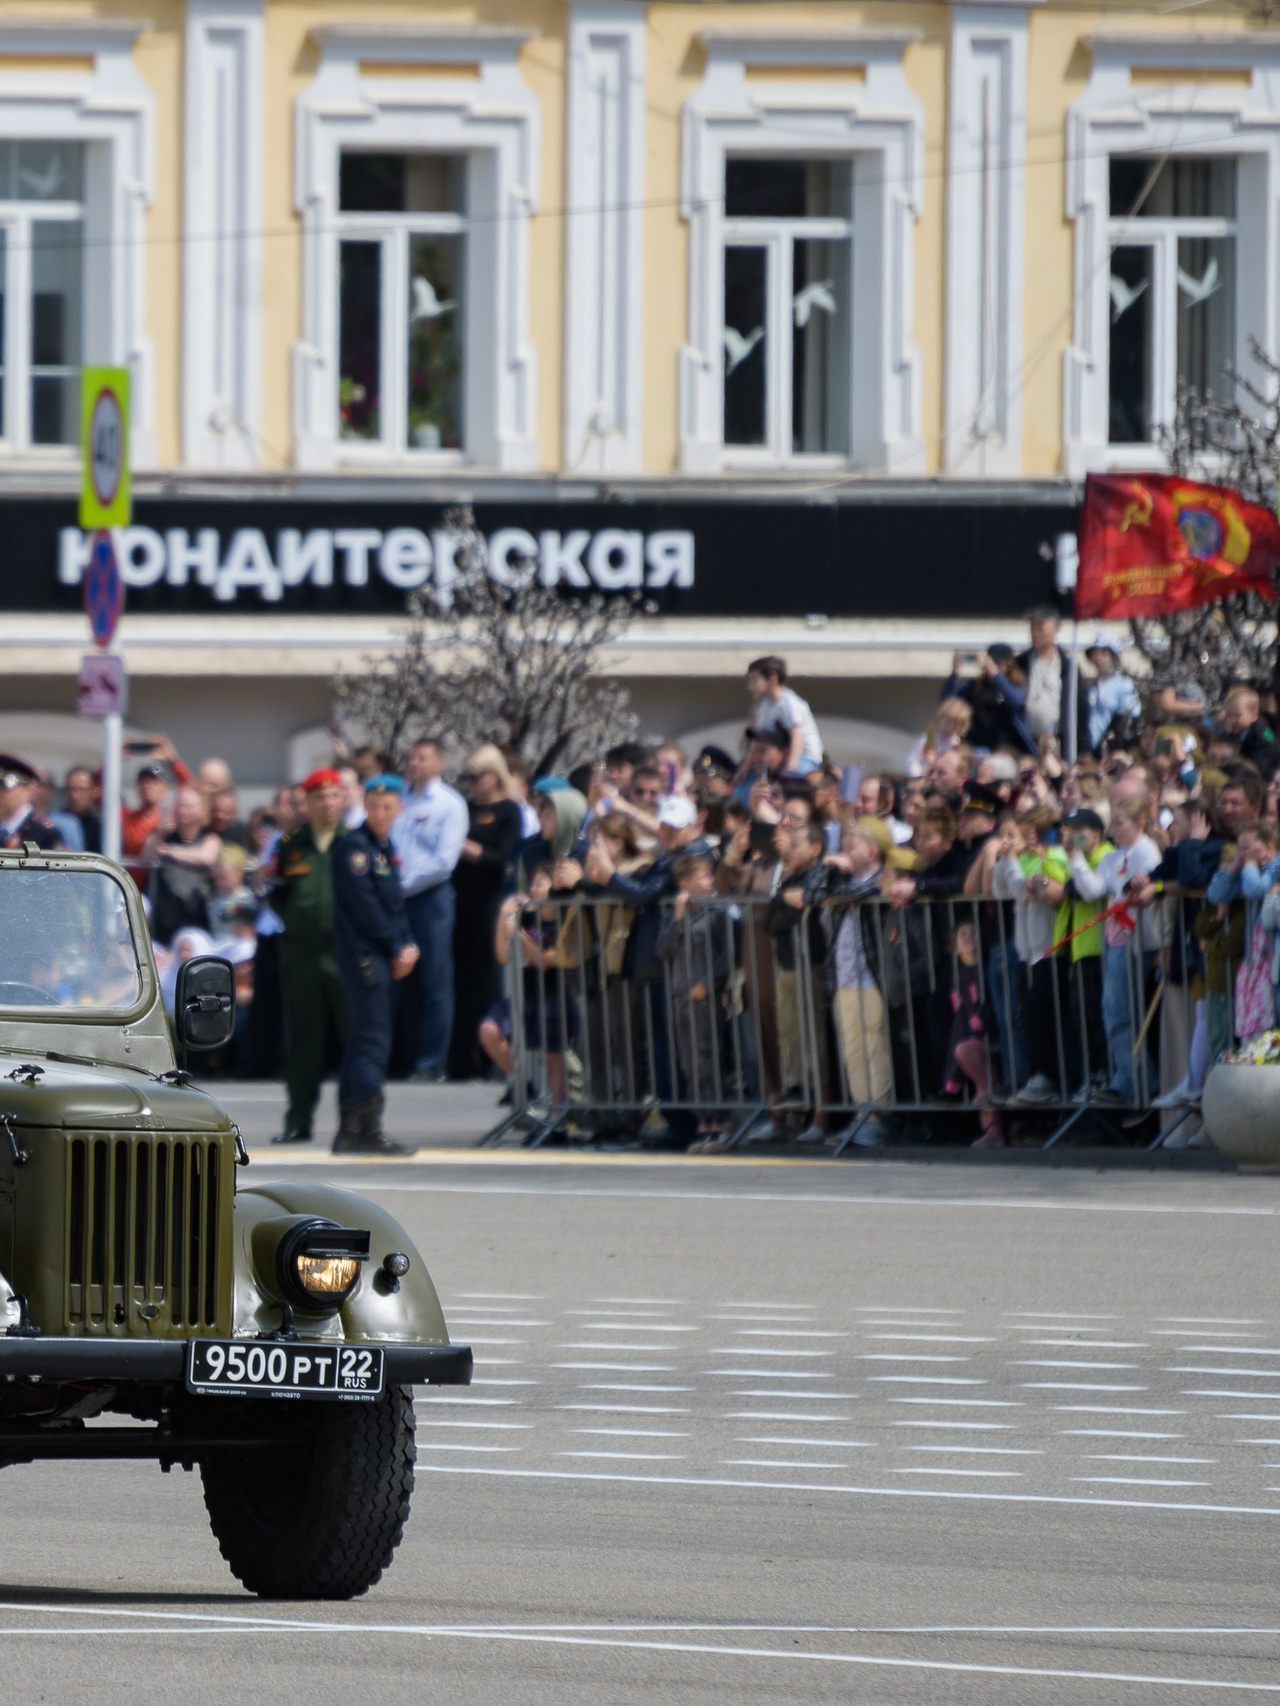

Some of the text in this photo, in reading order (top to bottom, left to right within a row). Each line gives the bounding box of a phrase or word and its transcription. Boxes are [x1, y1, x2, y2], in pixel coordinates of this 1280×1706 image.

[58, 525, 696, 601] кондитерская
[340, 1349, 373, 1378] 22
[344, 1377, 368, 1389] RUS
